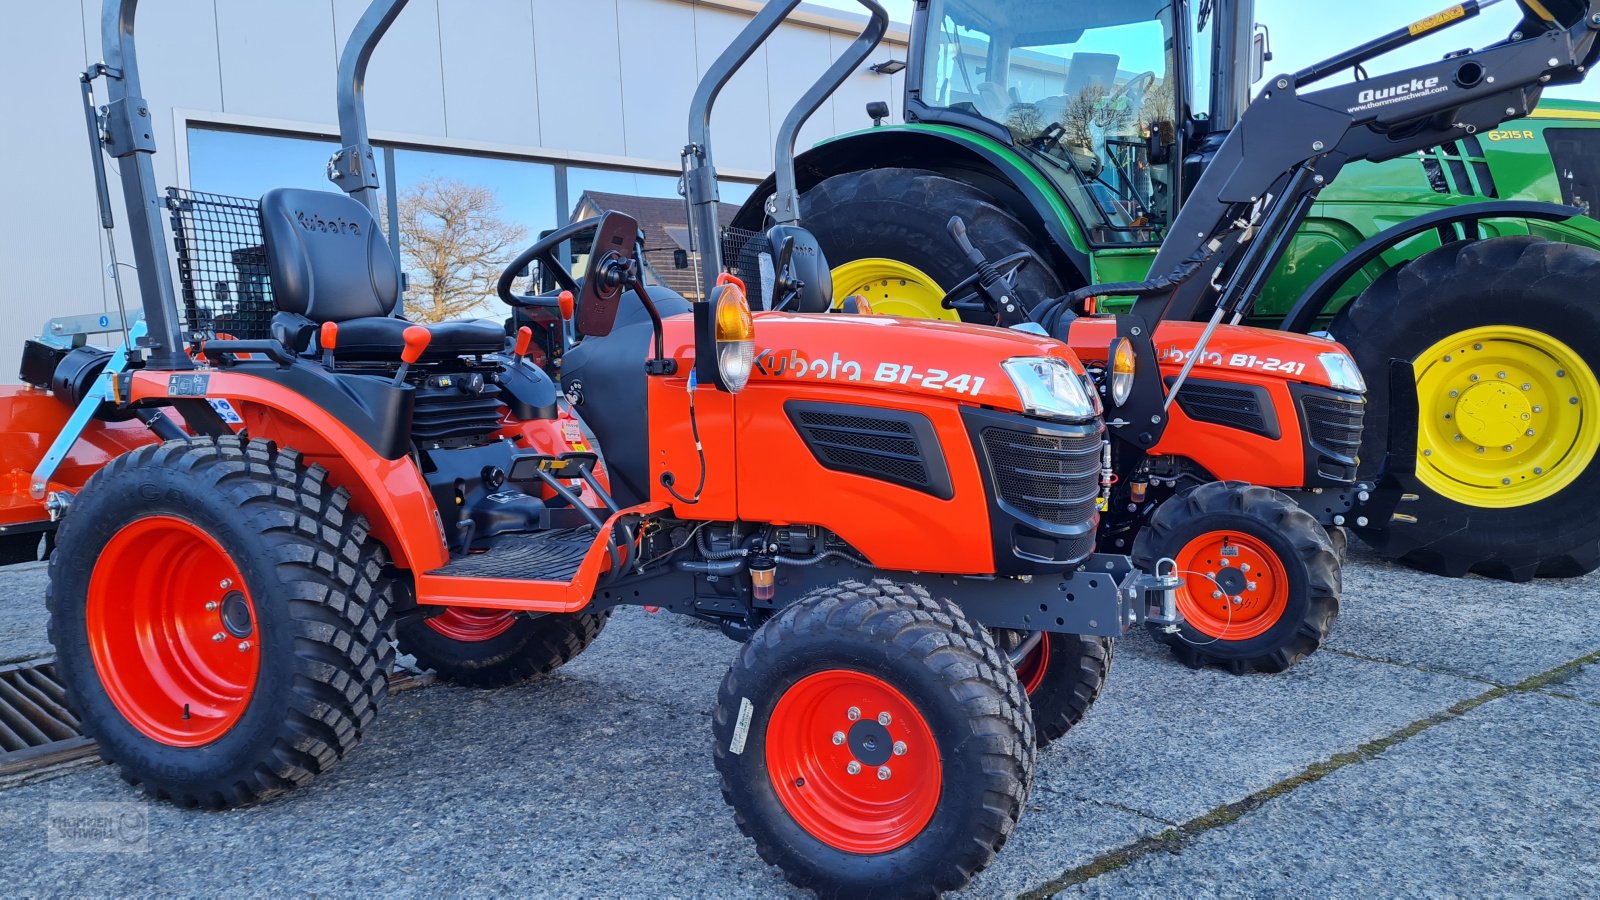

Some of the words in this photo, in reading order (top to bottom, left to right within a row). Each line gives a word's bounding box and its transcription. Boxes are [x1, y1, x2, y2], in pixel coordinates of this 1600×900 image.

[1347, 86, 1448, 113] www.thommenschwall.com
[1358, 76, 1439, 103] Quicke
[1488, 130, 1522, 141] 6215
[1522, 130, 1535, 139] R
[295, 210, 361, 236] Kubota
[1229, 353, 1305, 375] B1-241
[874, 362, 985, 396] B1-241
